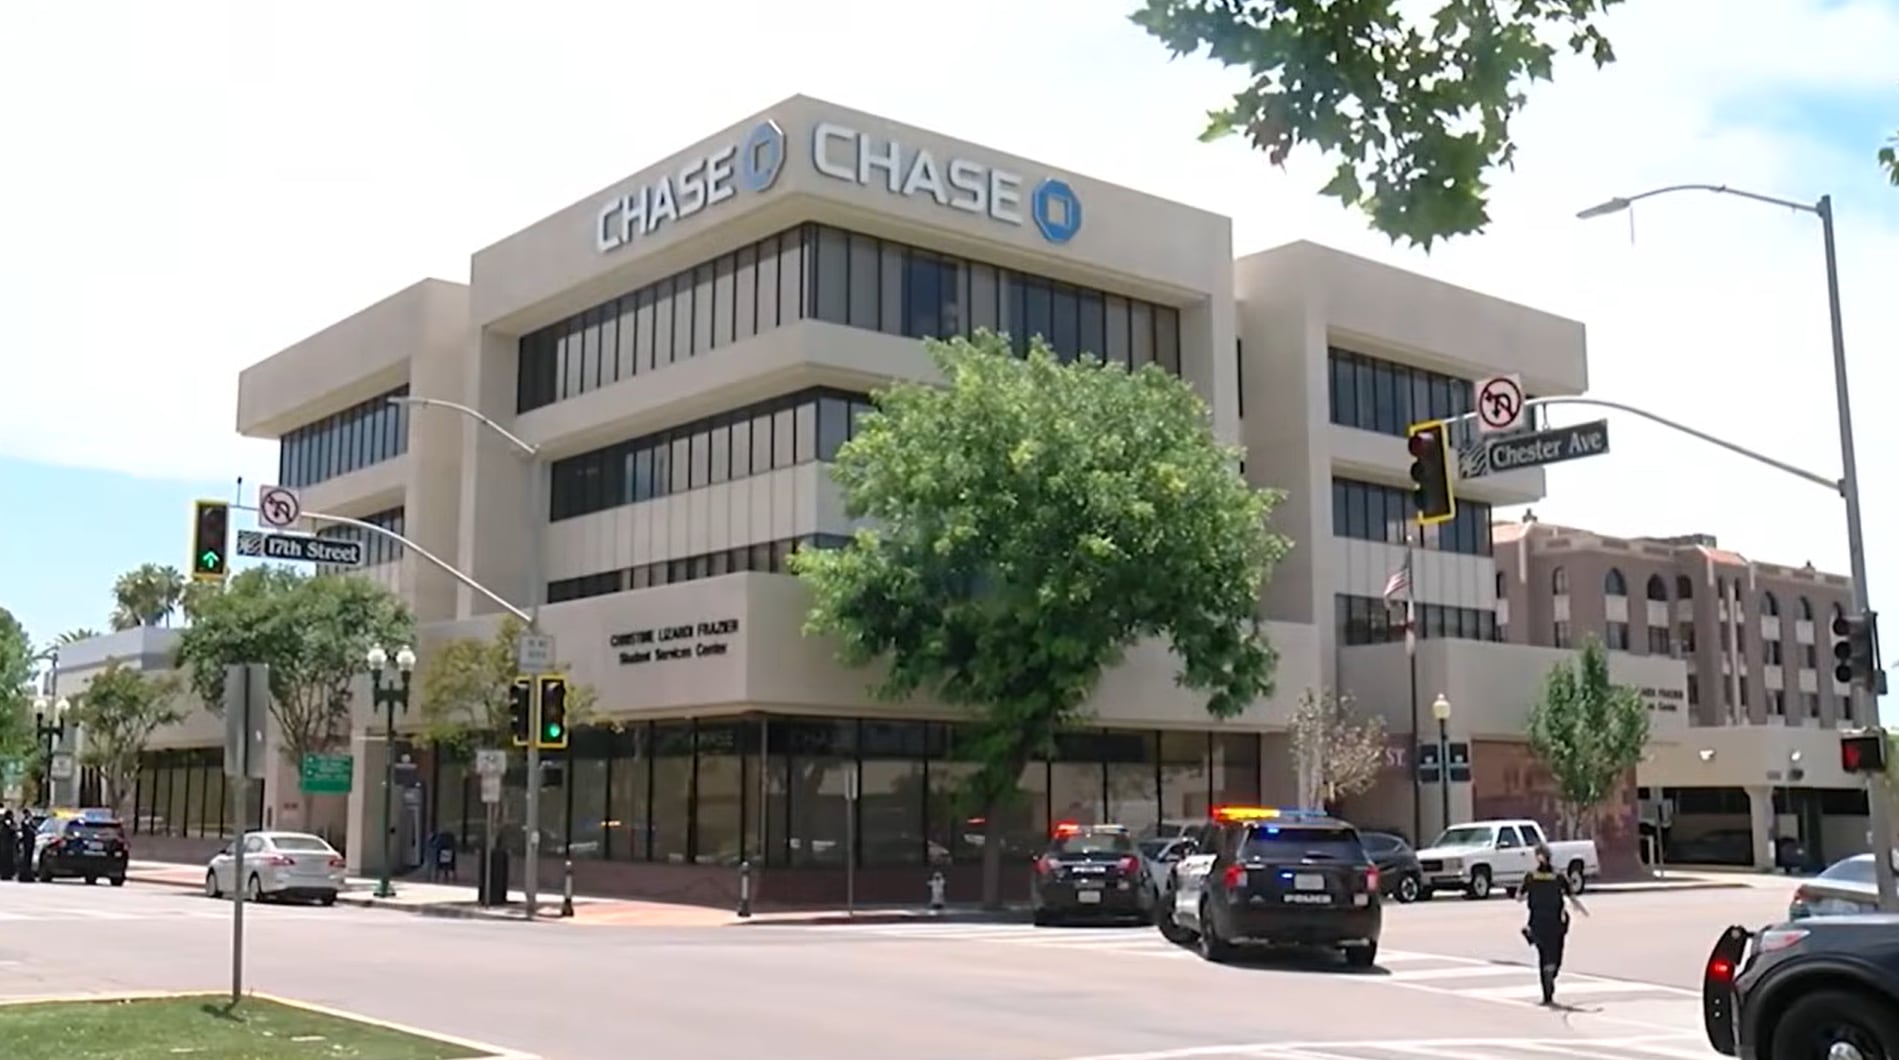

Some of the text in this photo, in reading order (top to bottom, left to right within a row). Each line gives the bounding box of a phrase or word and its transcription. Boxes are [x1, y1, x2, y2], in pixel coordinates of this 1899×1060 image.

[813, 122, 1024, 226] CHASE
[595, 146, 738, 253] CHASE
[1494, 432, 1602, 466] Chester Ave
[268, 538, 358, 562] 17th Street
[697, 619, 738, 636] FRAZIER
[618, 642, 728, 666] Student Services Center
